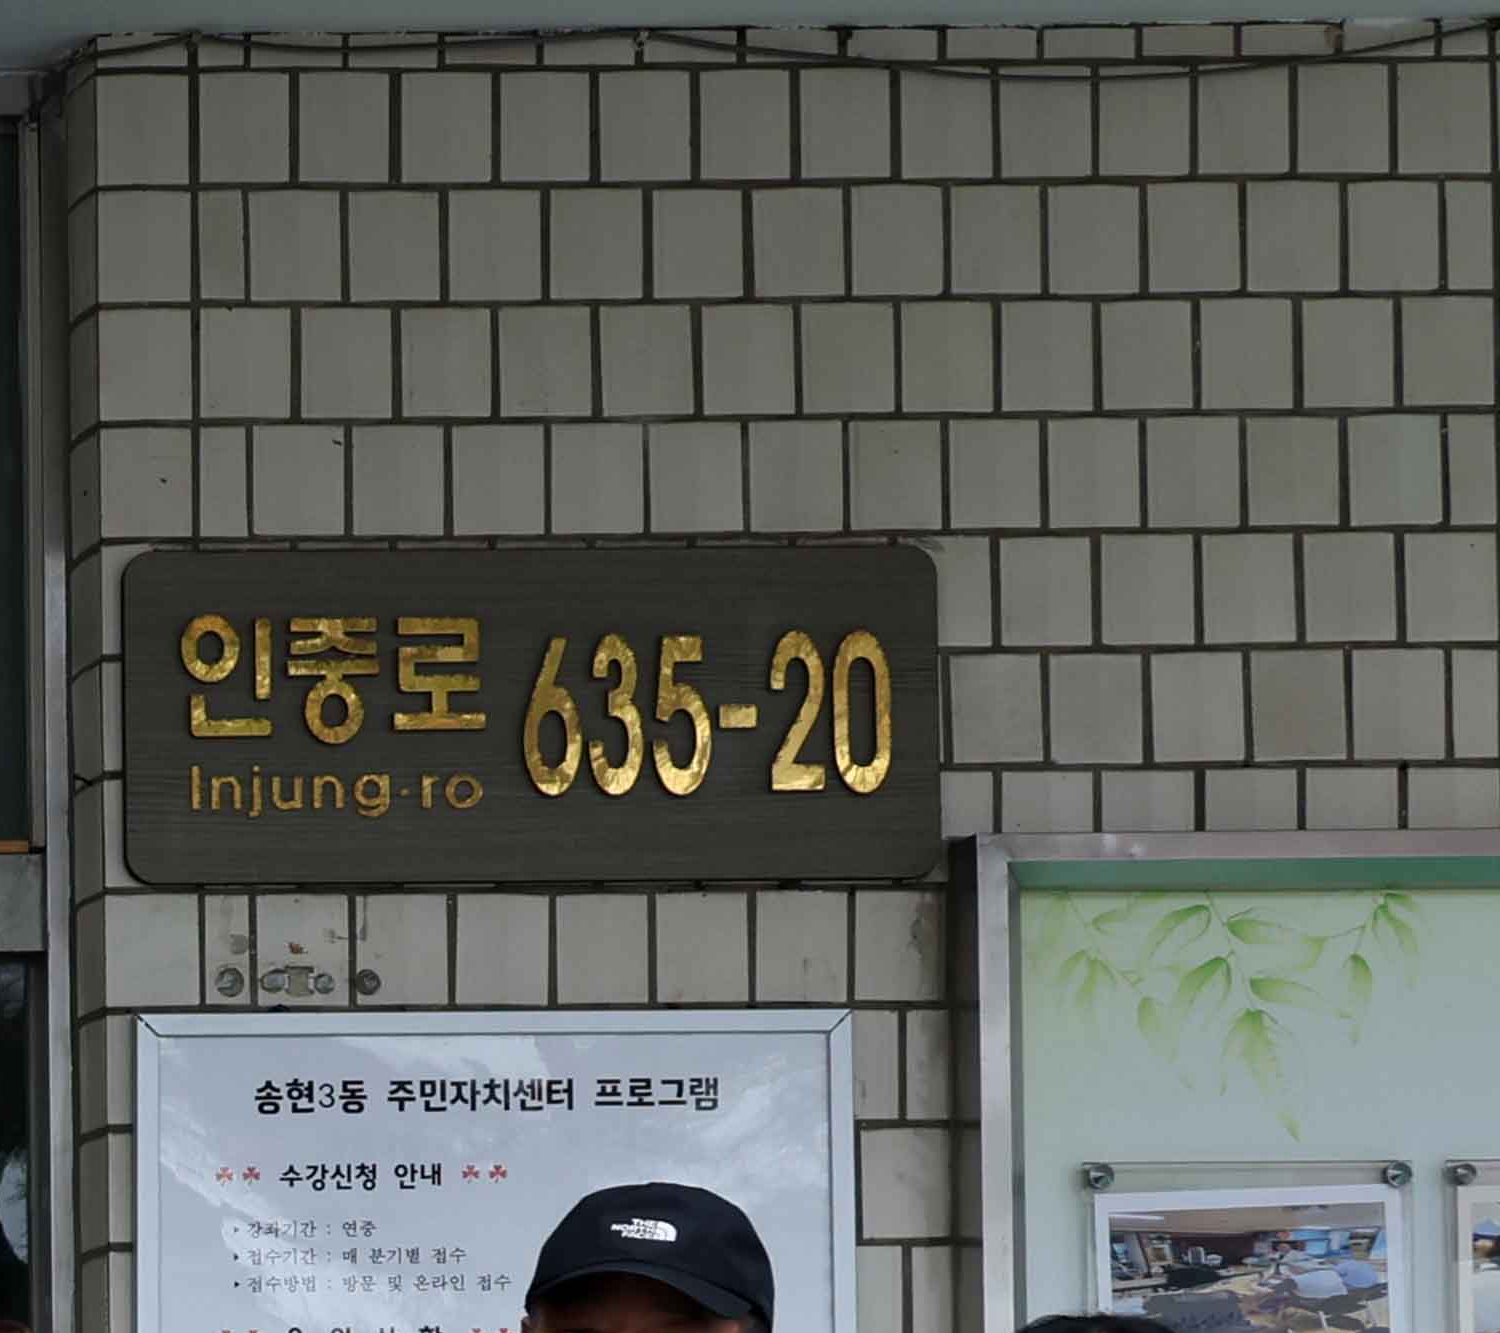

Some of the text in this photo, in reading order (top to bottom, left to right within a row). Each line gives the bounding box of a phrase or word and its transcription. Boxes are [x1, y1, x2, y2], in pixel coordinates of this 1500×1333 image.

[179, 614, 486, 745] 인중로
[523, 629, 892, 796] 635-20
[255, 1078, 717, 1114] 송현3동 주민자치센터 프로그램
[280, 1163, 441, 1191] 수강신청 안내
[342, 1219, 377, 1237] 연중
[343, 1248, 357, 1265] 매
[370, 1248, 420, 1265] 분기별
[432, 1248, 467, 1264] 접수
[343, 1274, 378, 1292] 방문
[389, 1274, 402, 1291] 및
[414, 1274, 465, 1291] 온라인
[477, 1274, 512, 1290] 접수
